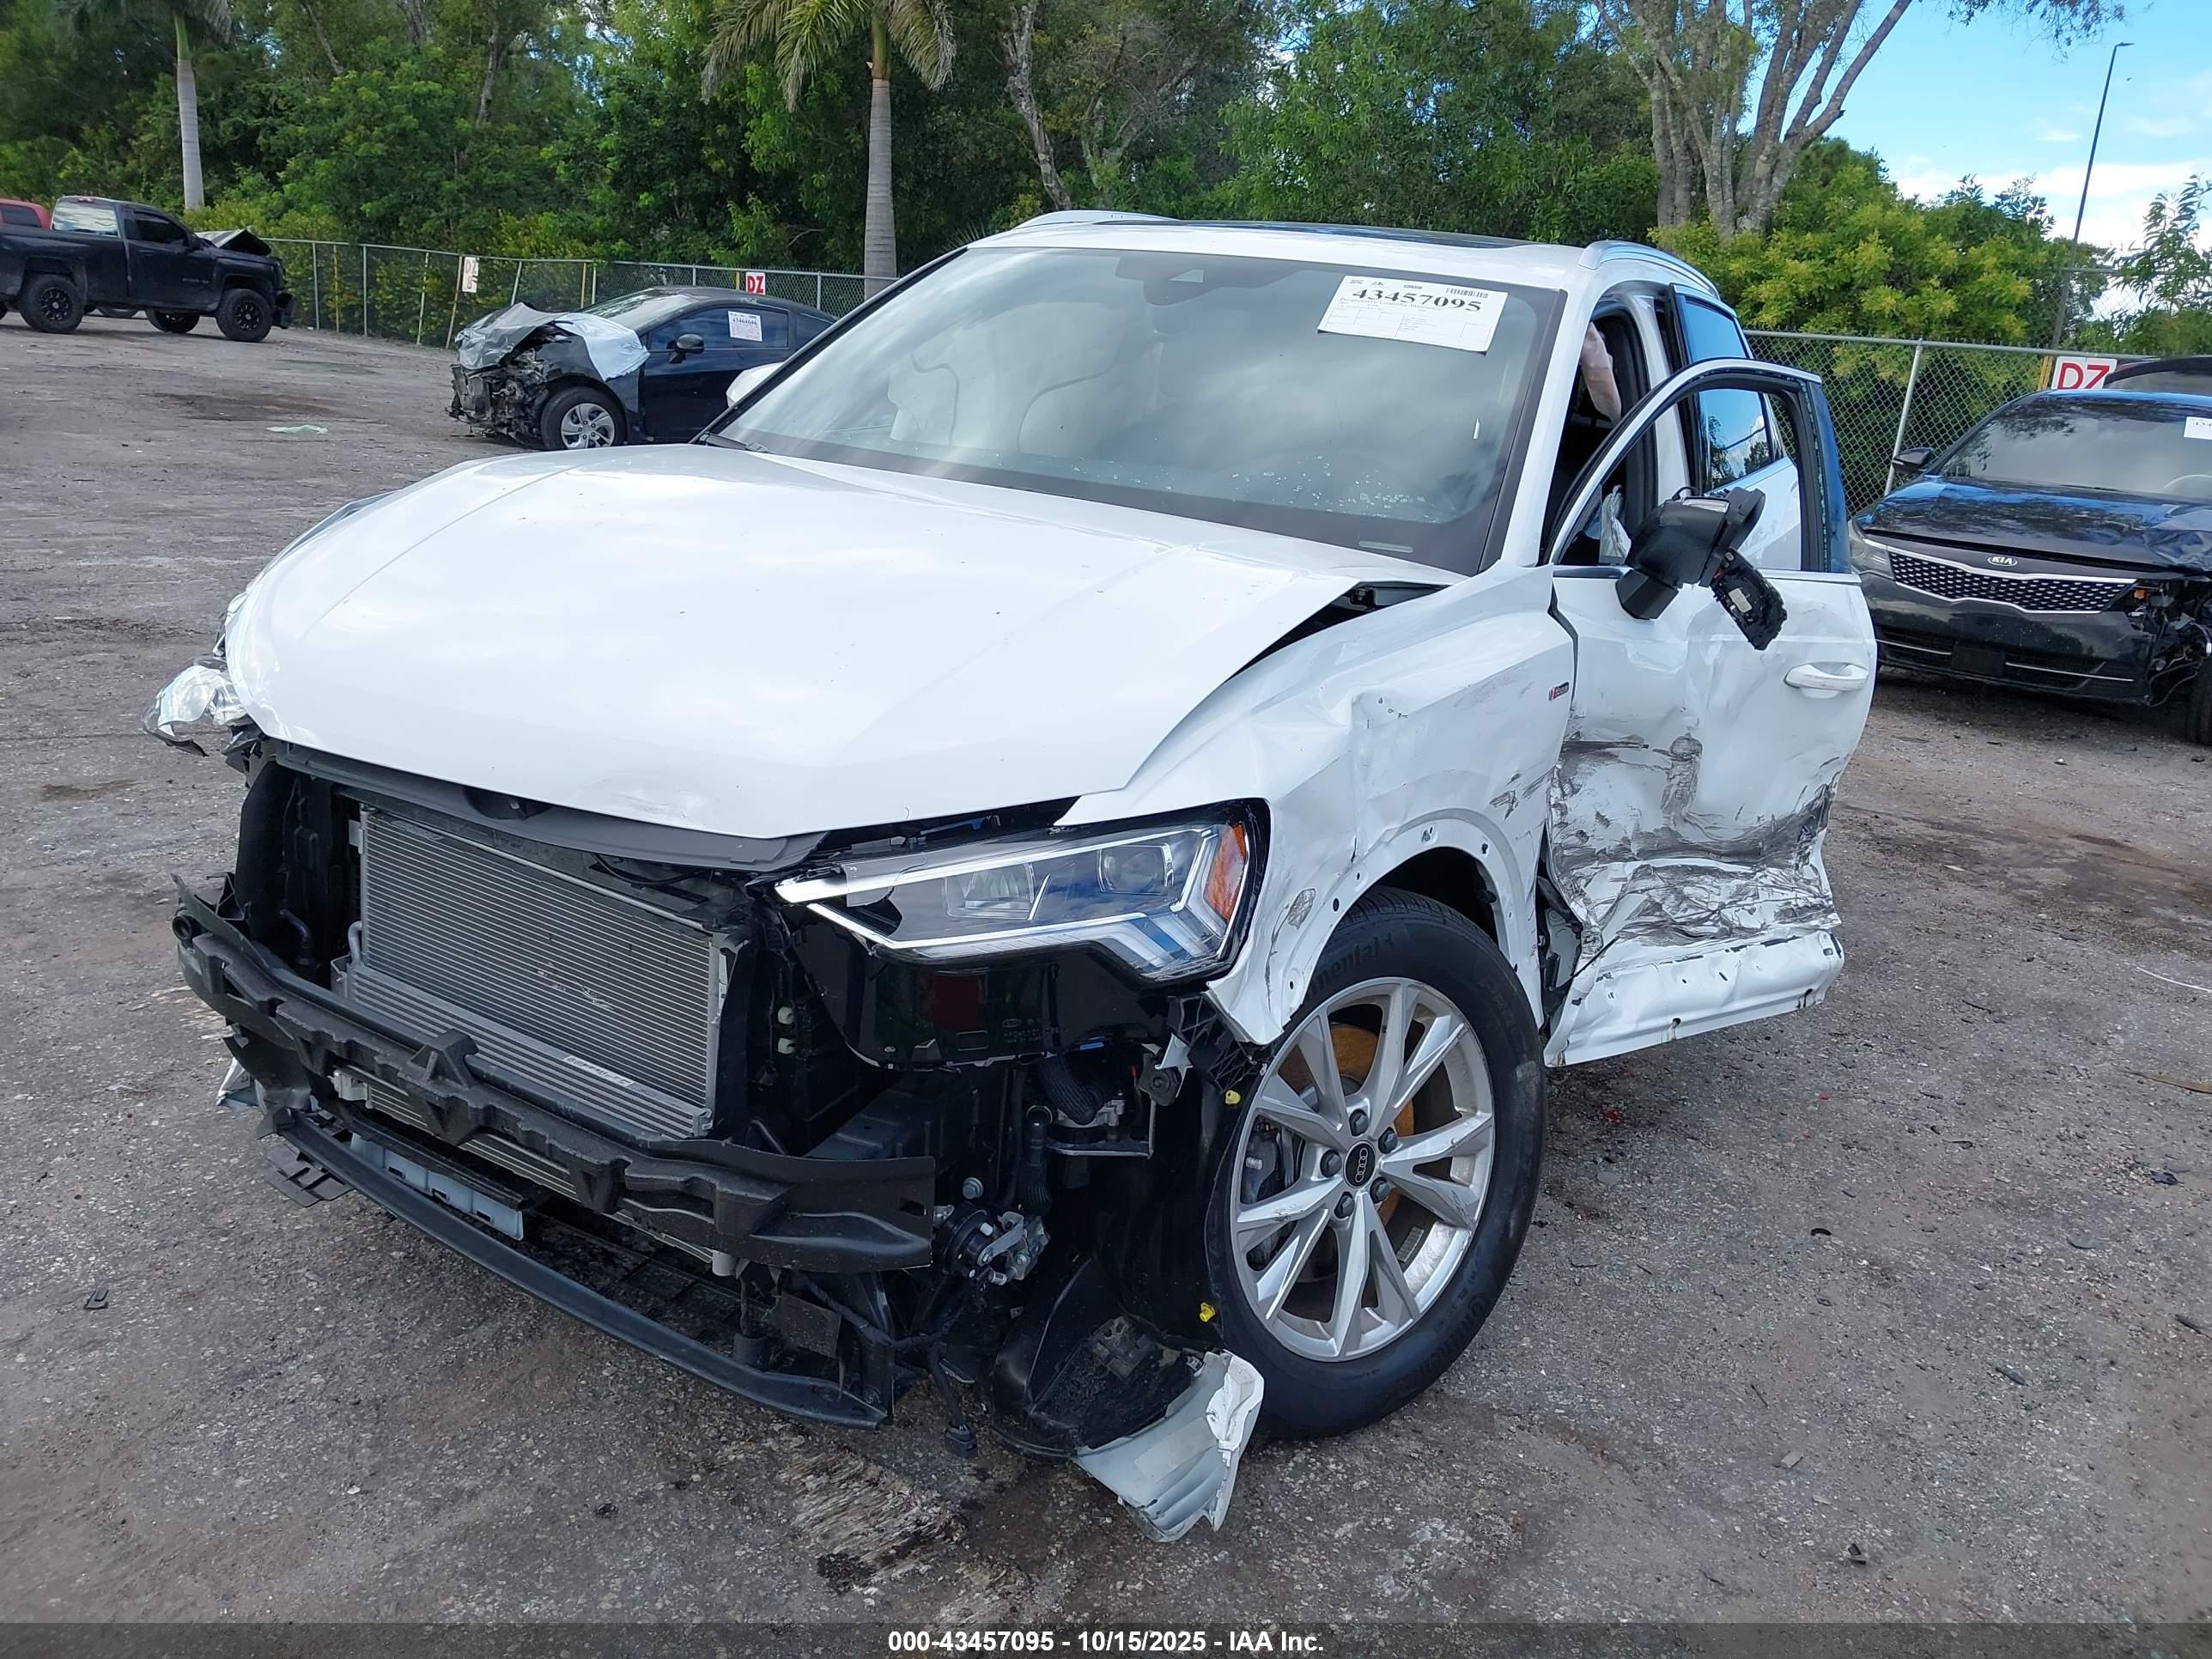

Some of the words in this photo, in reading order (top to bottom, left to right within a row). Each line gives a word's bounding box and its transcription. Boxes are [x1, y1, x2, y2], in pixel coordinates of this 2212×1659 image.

[747, 275, 764, 294] DZ
[1352, 288, 1482, 313] 43457095
[2057, 362, 2111, 390] DZ
[1991, 556, 2013, 565] KIA
